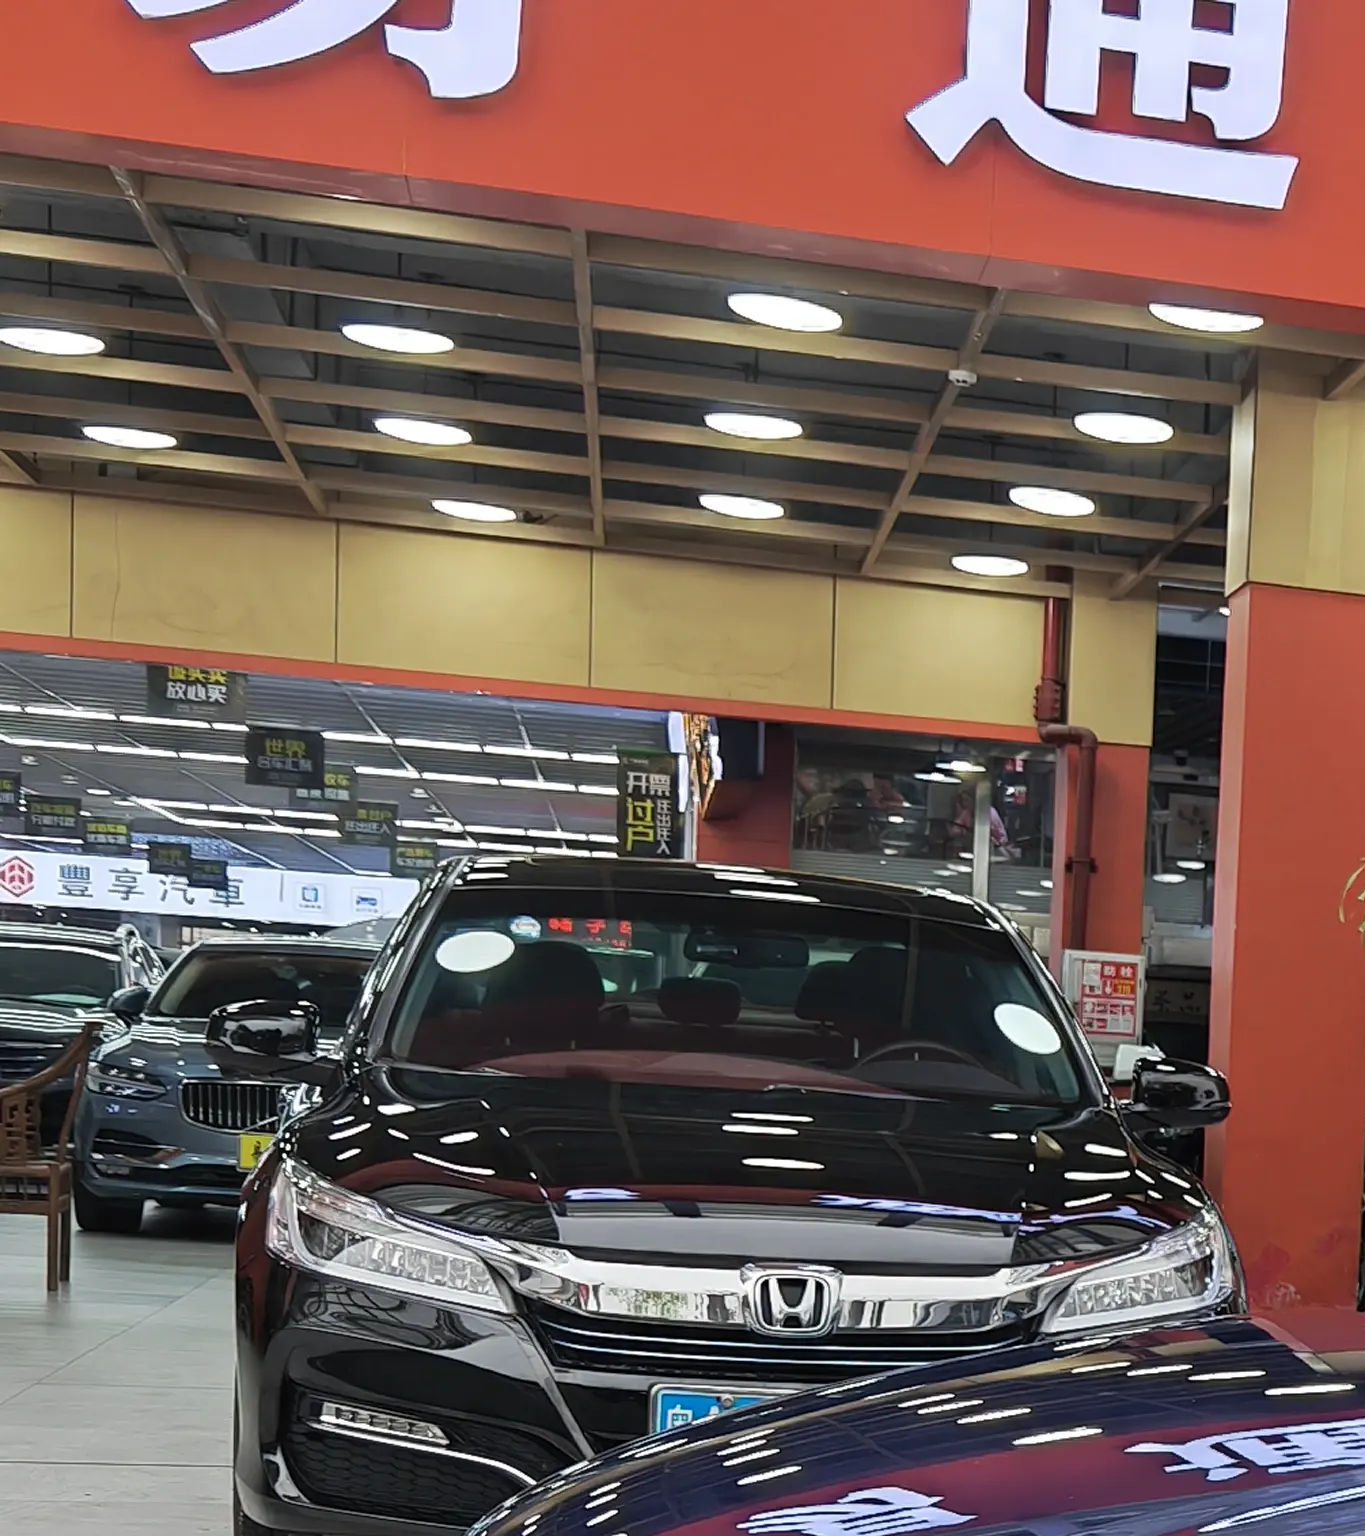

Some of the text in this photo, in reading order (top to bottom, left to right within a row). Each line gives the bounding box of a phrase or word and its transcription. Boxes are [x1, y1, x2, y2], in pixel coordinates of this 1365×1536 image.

[166, 681, 228, 705] 放心买
[265, 738, 307, 758] 世界
[626, 771, 671, 796] 开票
[626, 797, 655, 851] 过户
